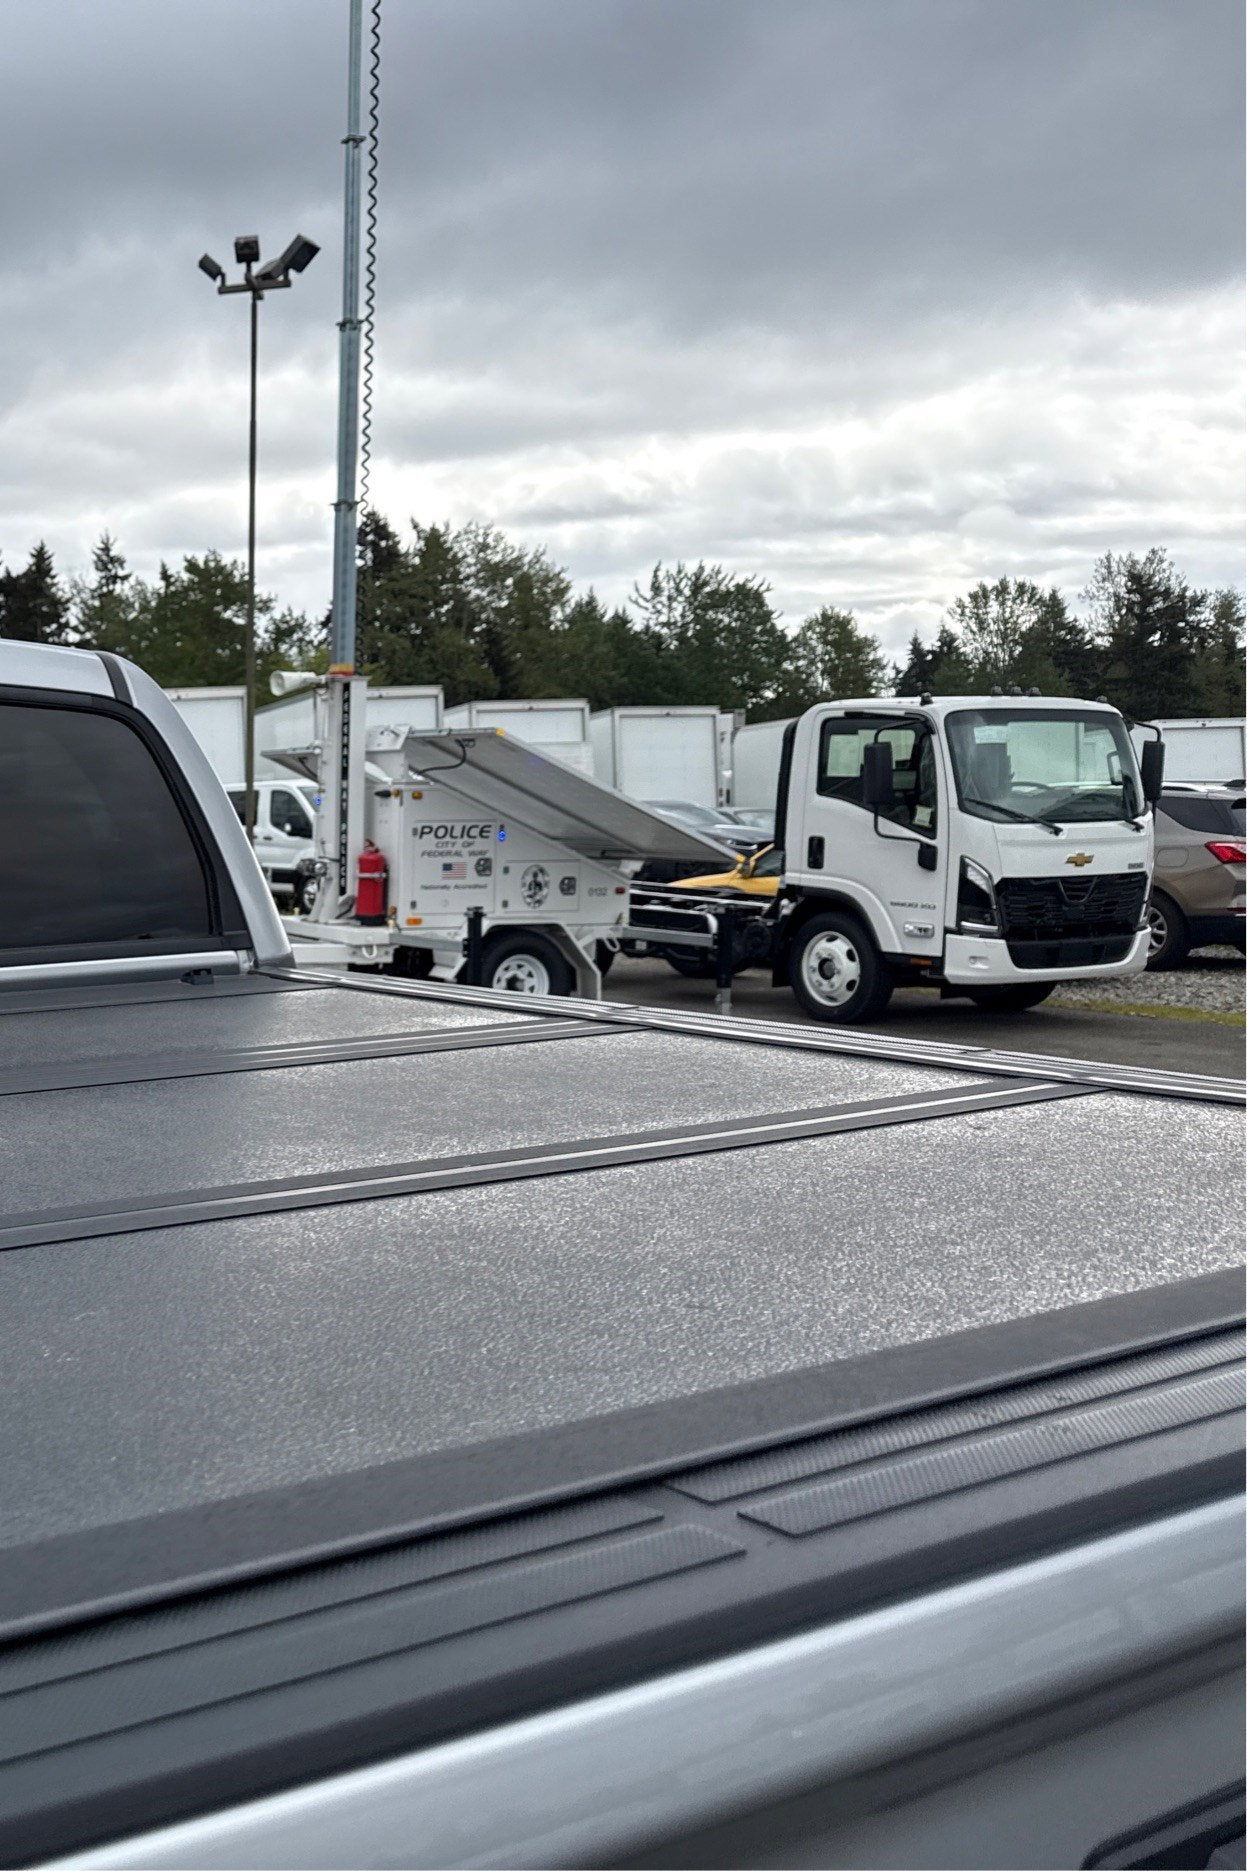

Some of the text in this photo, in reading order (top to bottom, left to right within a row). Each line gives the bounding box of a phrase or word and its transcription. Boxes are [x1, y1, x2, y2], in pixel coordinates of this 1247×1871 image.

[419, 824, 492, 839] POLICE
[435, 840, 475, 848] CITY OF
[421, 849, 464, 858] FEDERAL
